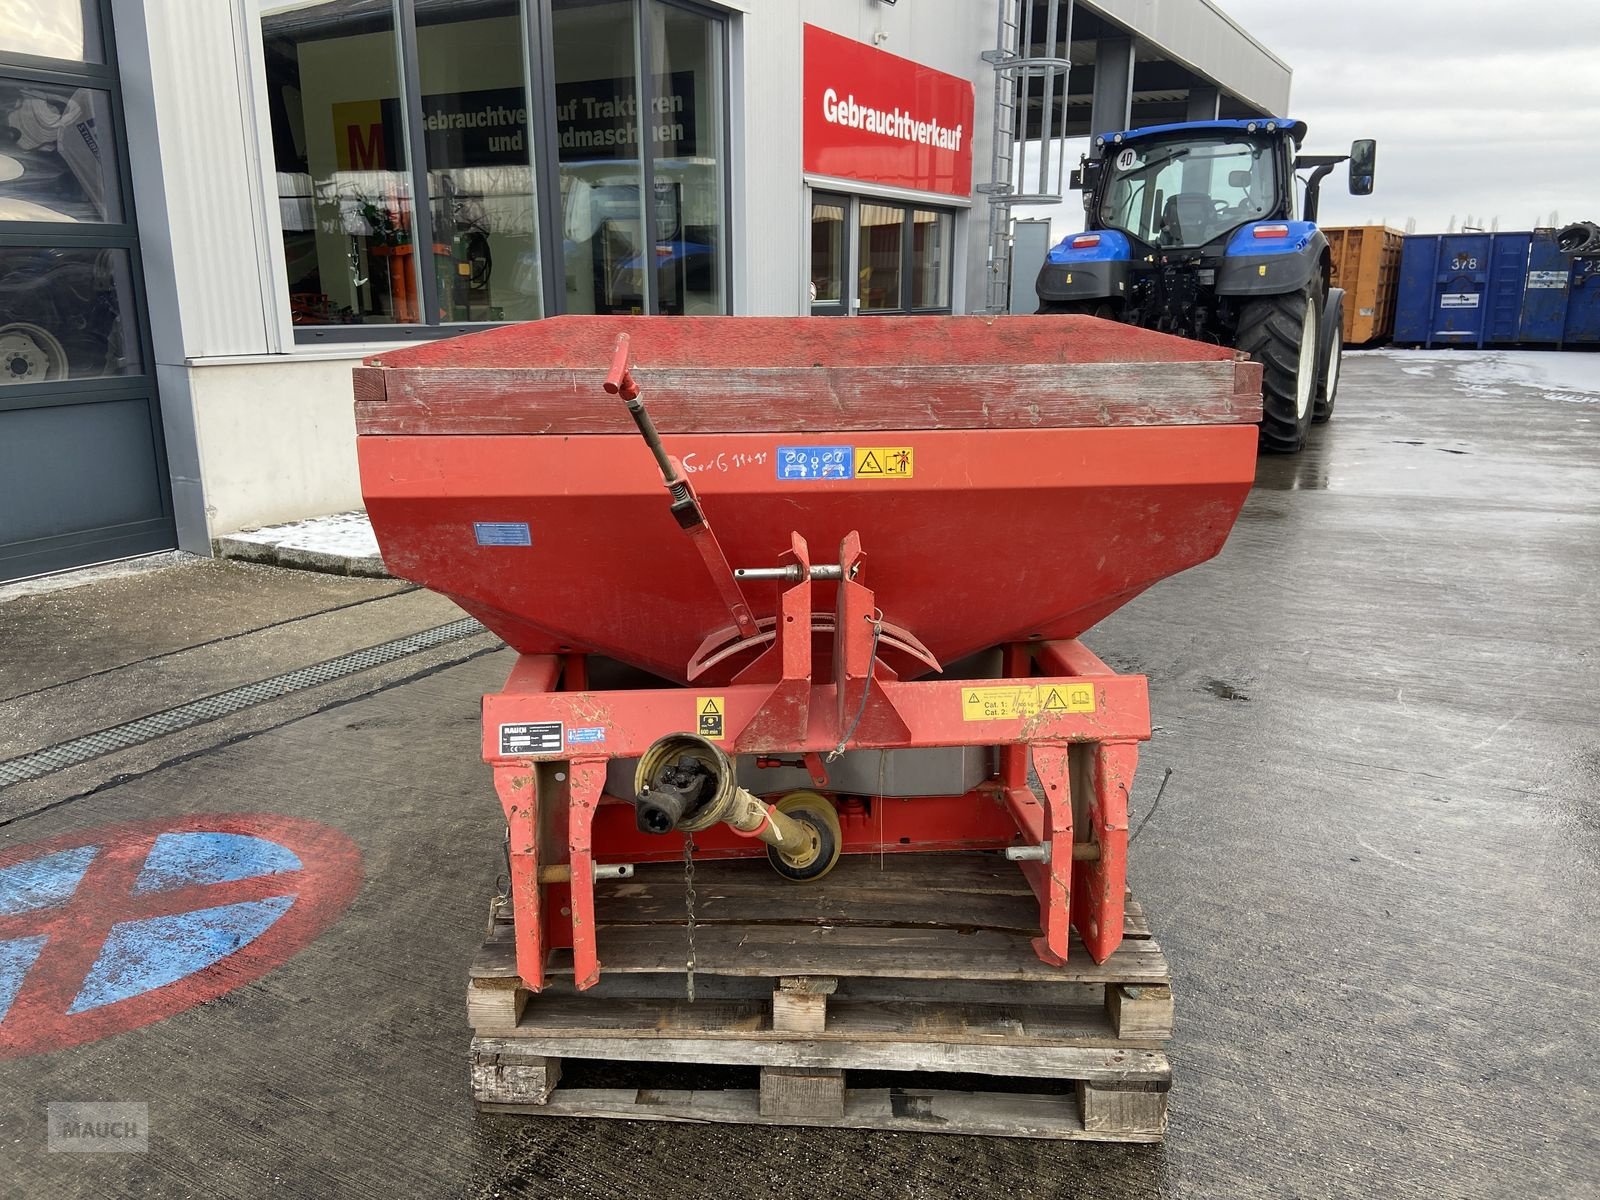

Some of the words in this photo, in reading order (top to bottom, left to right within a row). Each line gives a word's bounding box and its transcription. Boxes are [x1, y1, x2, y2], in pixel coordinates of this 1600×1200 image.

[582, 95, 683, 119] Traktren
[823, 88, 962, 151] Gebrauchtverkauf
[347, 124, 385, 170] M
[488, 130, 522, 152] und
[1120, 152, 1133, 167] 40
[1451, 258, 1477, 270] 378
[984, 701, 999, 709] Cat.
